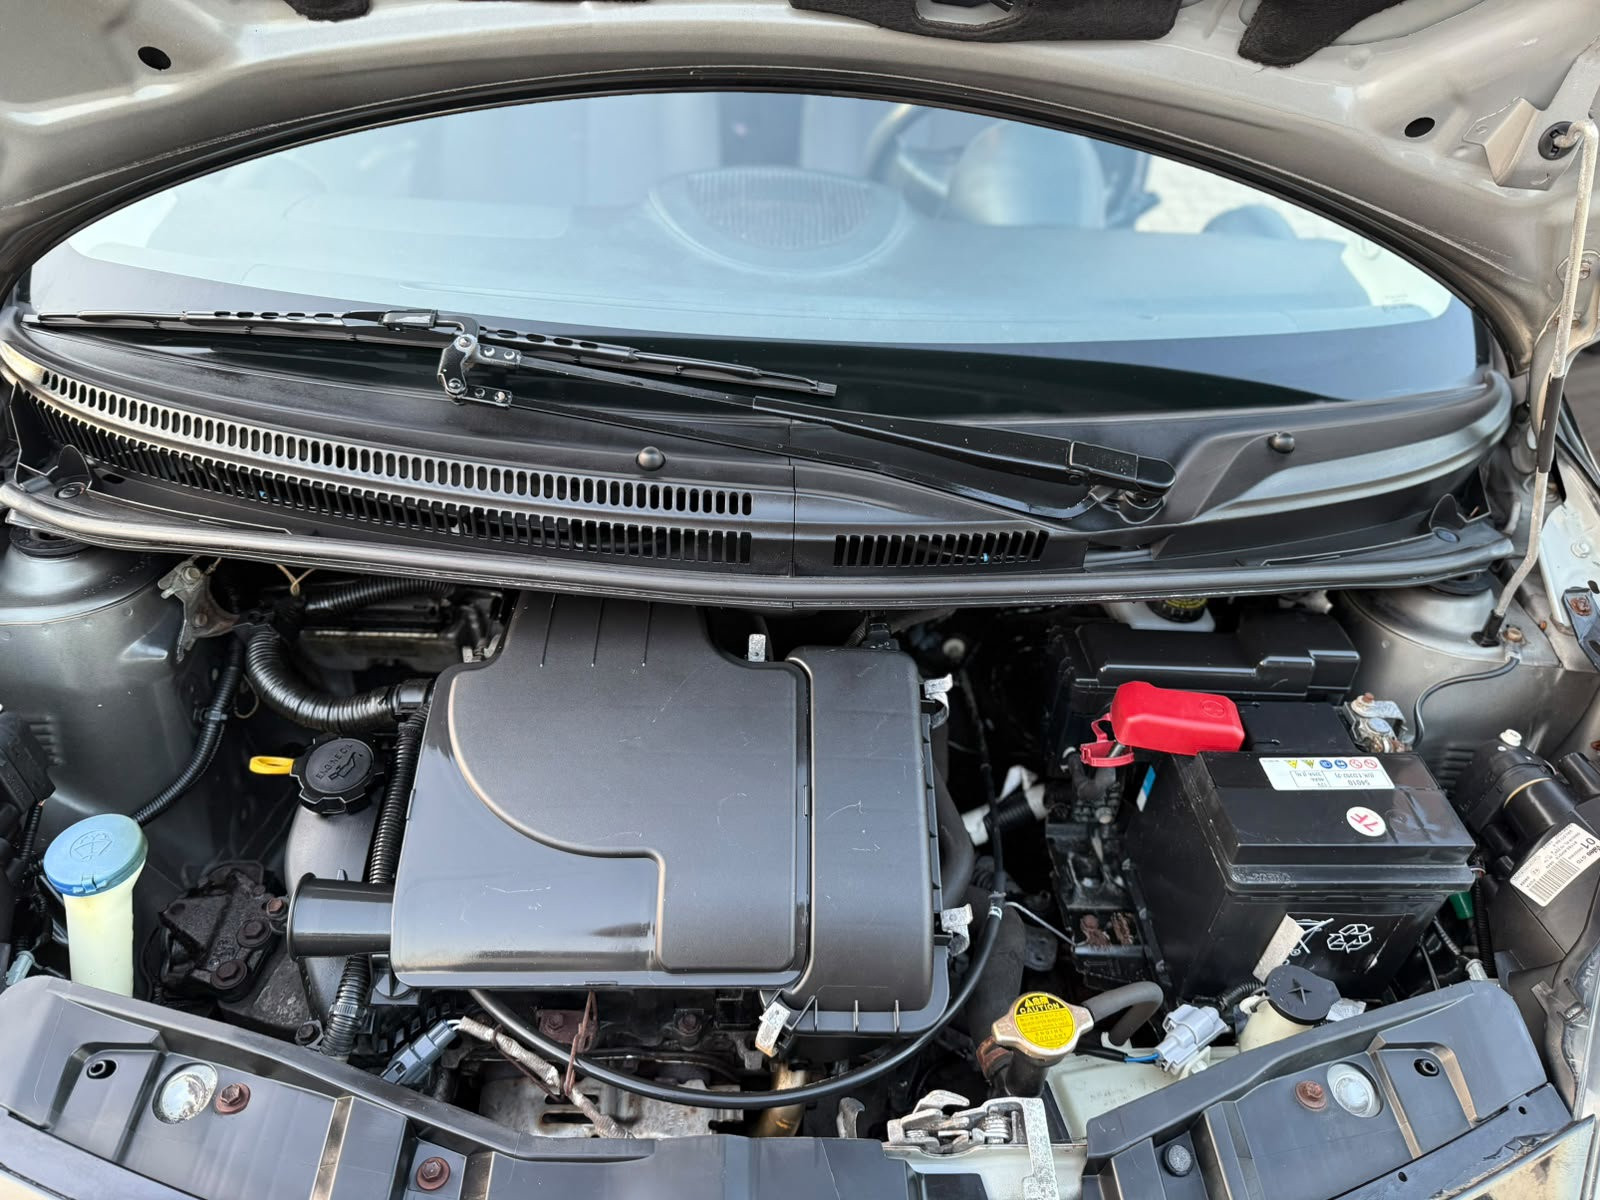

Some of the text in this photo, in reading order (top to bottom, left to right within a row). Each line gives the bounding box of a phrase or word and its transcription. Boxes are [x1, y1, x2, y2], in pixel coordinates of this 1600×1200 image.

[315, 753, 342, 779] ENGINE
[1347, 779, 1370, 787] 54010
[1350, 813, 1379, 832] 7F
[1580, 838, 1596, 849] 01
[1020, 1002, 1060, 1014] CAUTION
